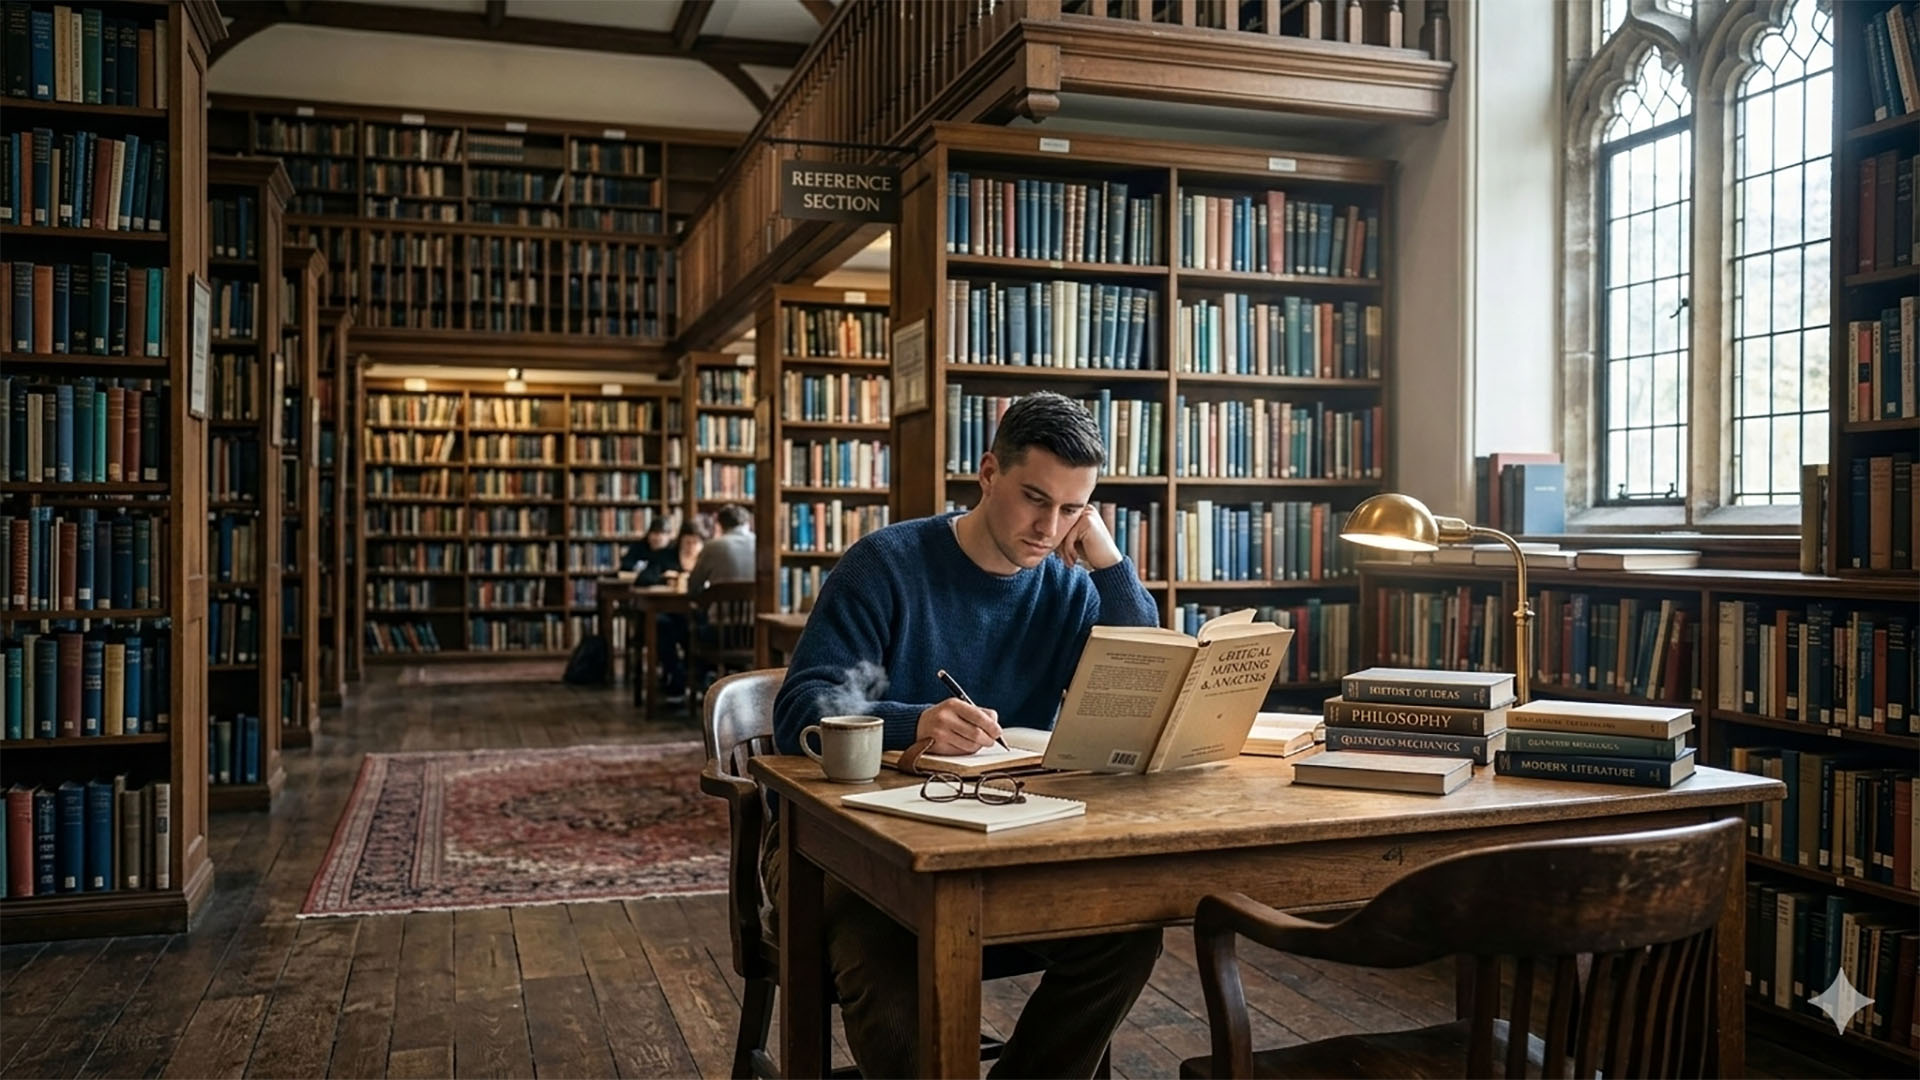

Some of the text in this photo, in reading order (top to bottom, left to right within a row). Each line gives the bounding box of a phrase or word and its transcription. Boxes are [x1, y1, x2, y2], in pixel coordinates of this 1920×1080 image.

[791, 170, 892, 192] REFERENCE
[803, 193, 880, 212] SECTION
[1352, 709, 1452, 728] PHILOSOPHY
